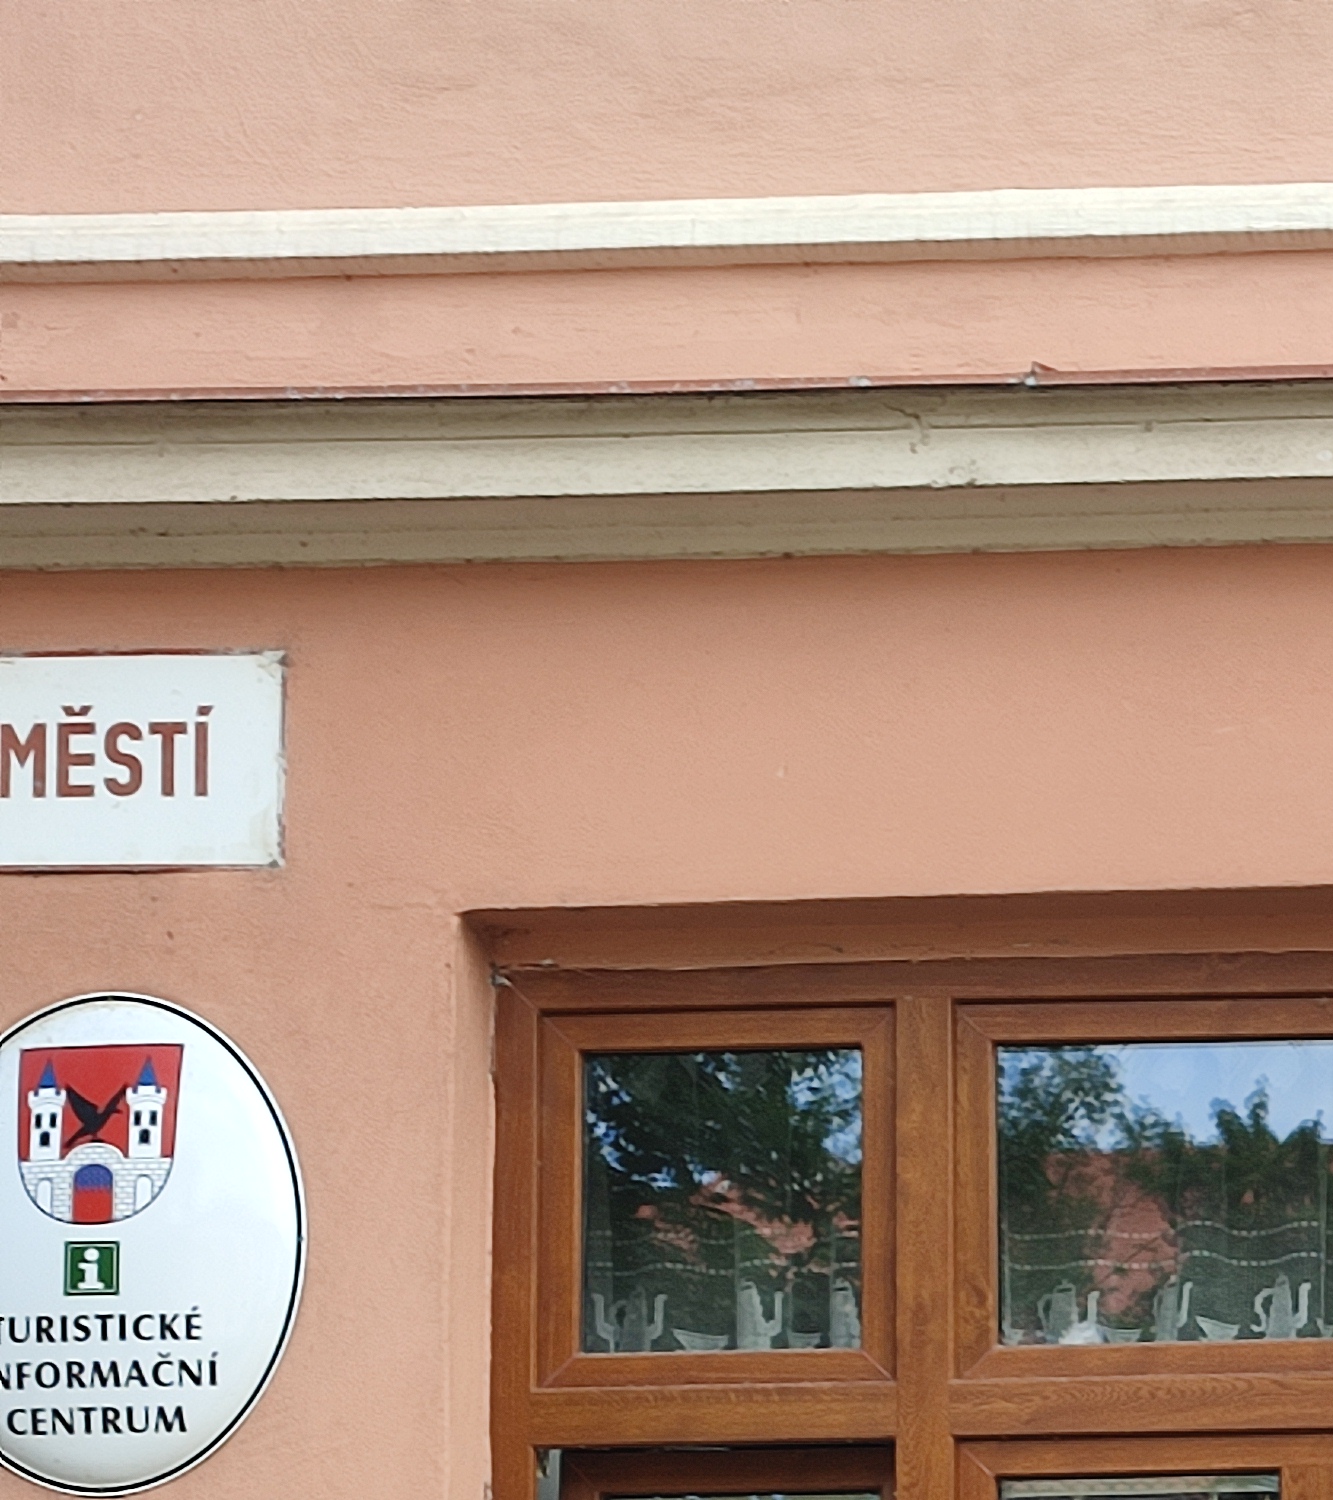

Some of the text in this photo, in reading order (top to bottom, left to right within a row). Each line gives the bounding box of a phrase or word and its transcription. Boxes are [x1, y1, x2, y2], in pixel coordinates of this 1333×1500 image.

[0, 705, 214, 798] MĚSTÍ
[0, 1306, 203, 1345] URISTICKÉ
[7, 1405, 188, 1436] CENTRUM
